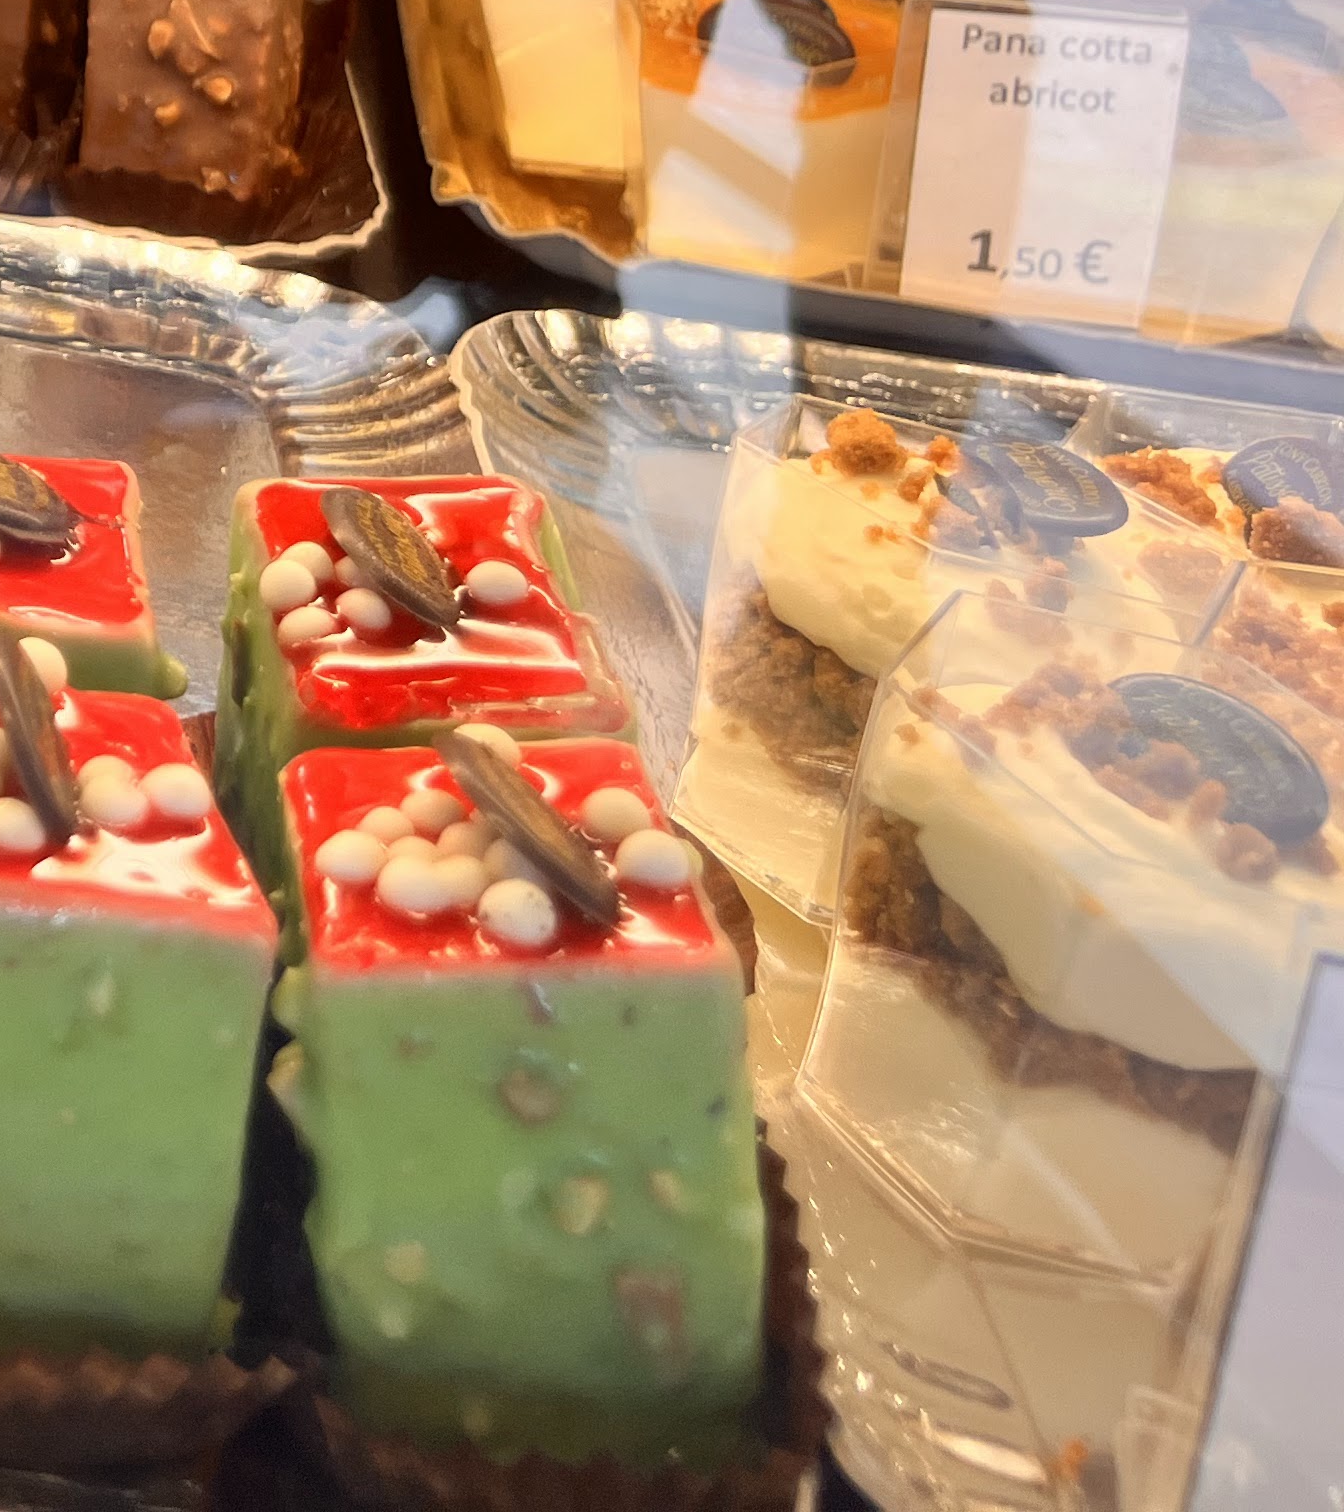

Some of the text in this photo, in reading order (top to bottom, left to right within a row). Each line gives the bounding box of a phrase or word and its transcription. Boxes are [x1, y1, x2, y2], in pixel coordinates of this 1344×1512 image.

[962, 23, 1154, 66] Pana cotta
[988, 76, 1117, 114] abricot
[966, 229, 1114, 285] 1,50 €
